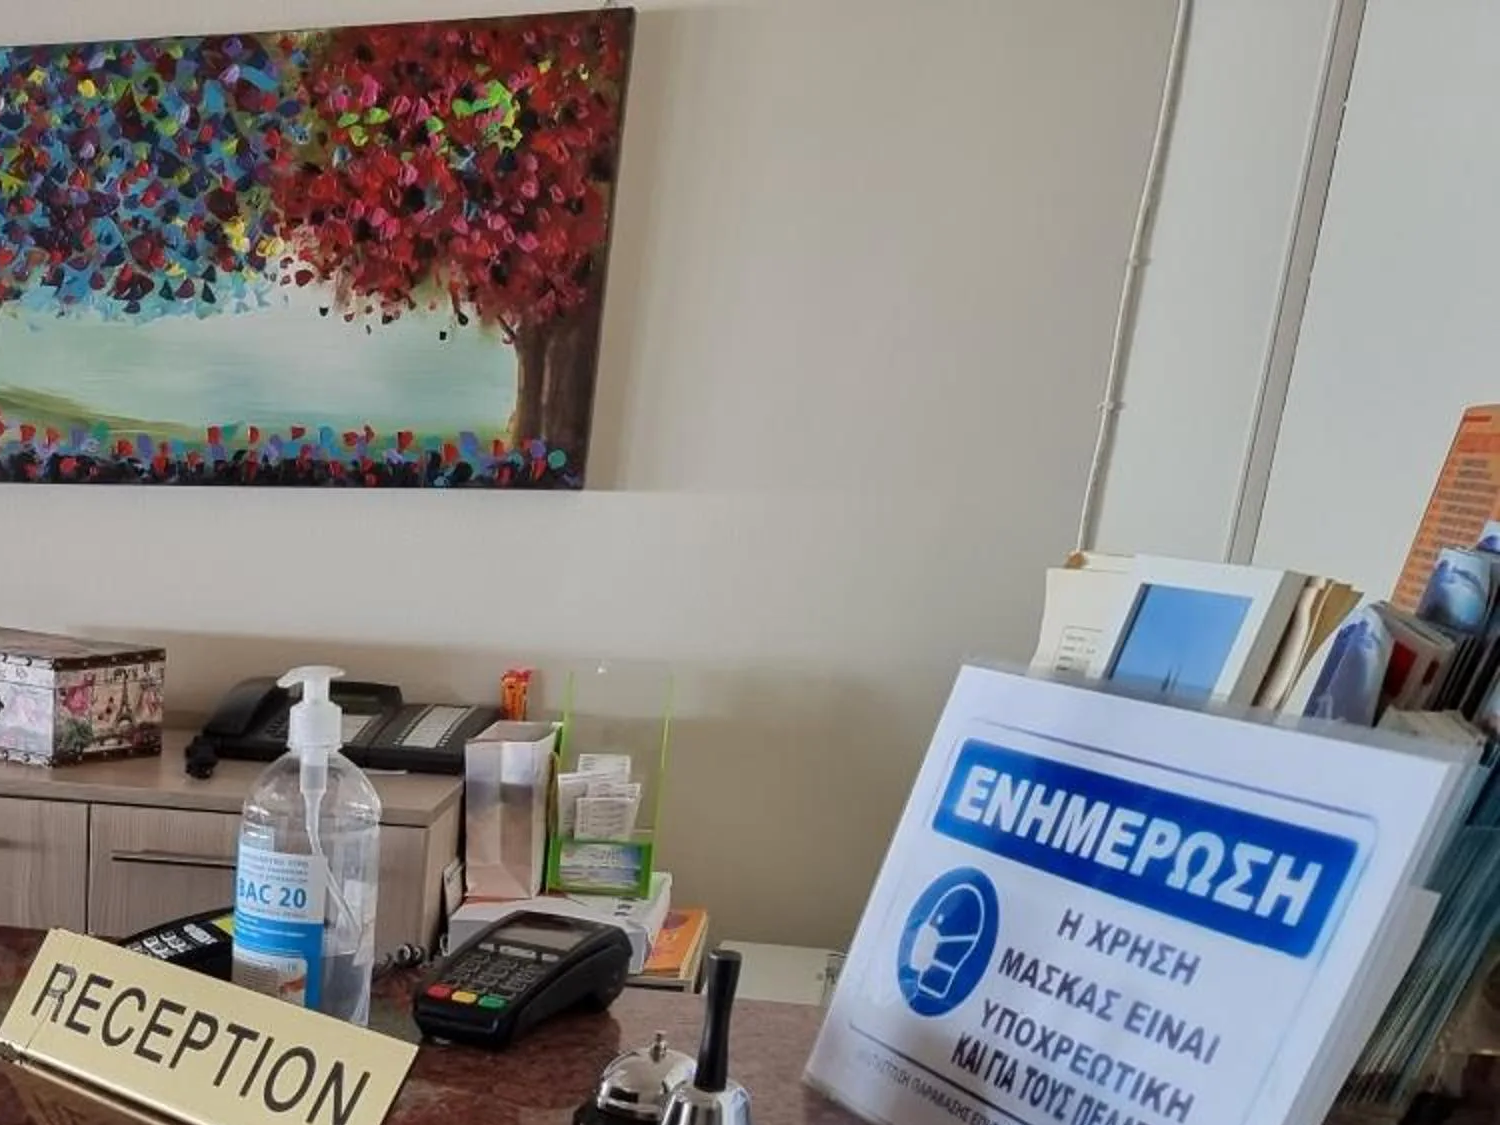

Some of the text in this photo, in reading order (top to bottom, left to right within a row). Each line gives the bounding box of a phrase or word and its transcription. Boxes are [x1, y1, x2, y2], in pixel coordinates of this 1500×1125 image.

[954, 765, 1322, 926] ΕΝΗΜΕΡΩΣΗ
[279, 886, 307, 910] 20
[1057, 908, 1201, 986] Η ΧΡΗΣΗ
[998, 947, 1221, 1065] ΜΑΣΚΑΣ ΕΙΝΑΙ
[952, 1032, 988, 1075] ΚΑΙ
[984, 1050, 1018, 1094] ΓΙΑ
[1018, 1066, 1076, 1121] ΤΟΥΣ
[981, 998, 1194, 1124] ΥΠΟΧΡΕΩΤΙΚΗ
